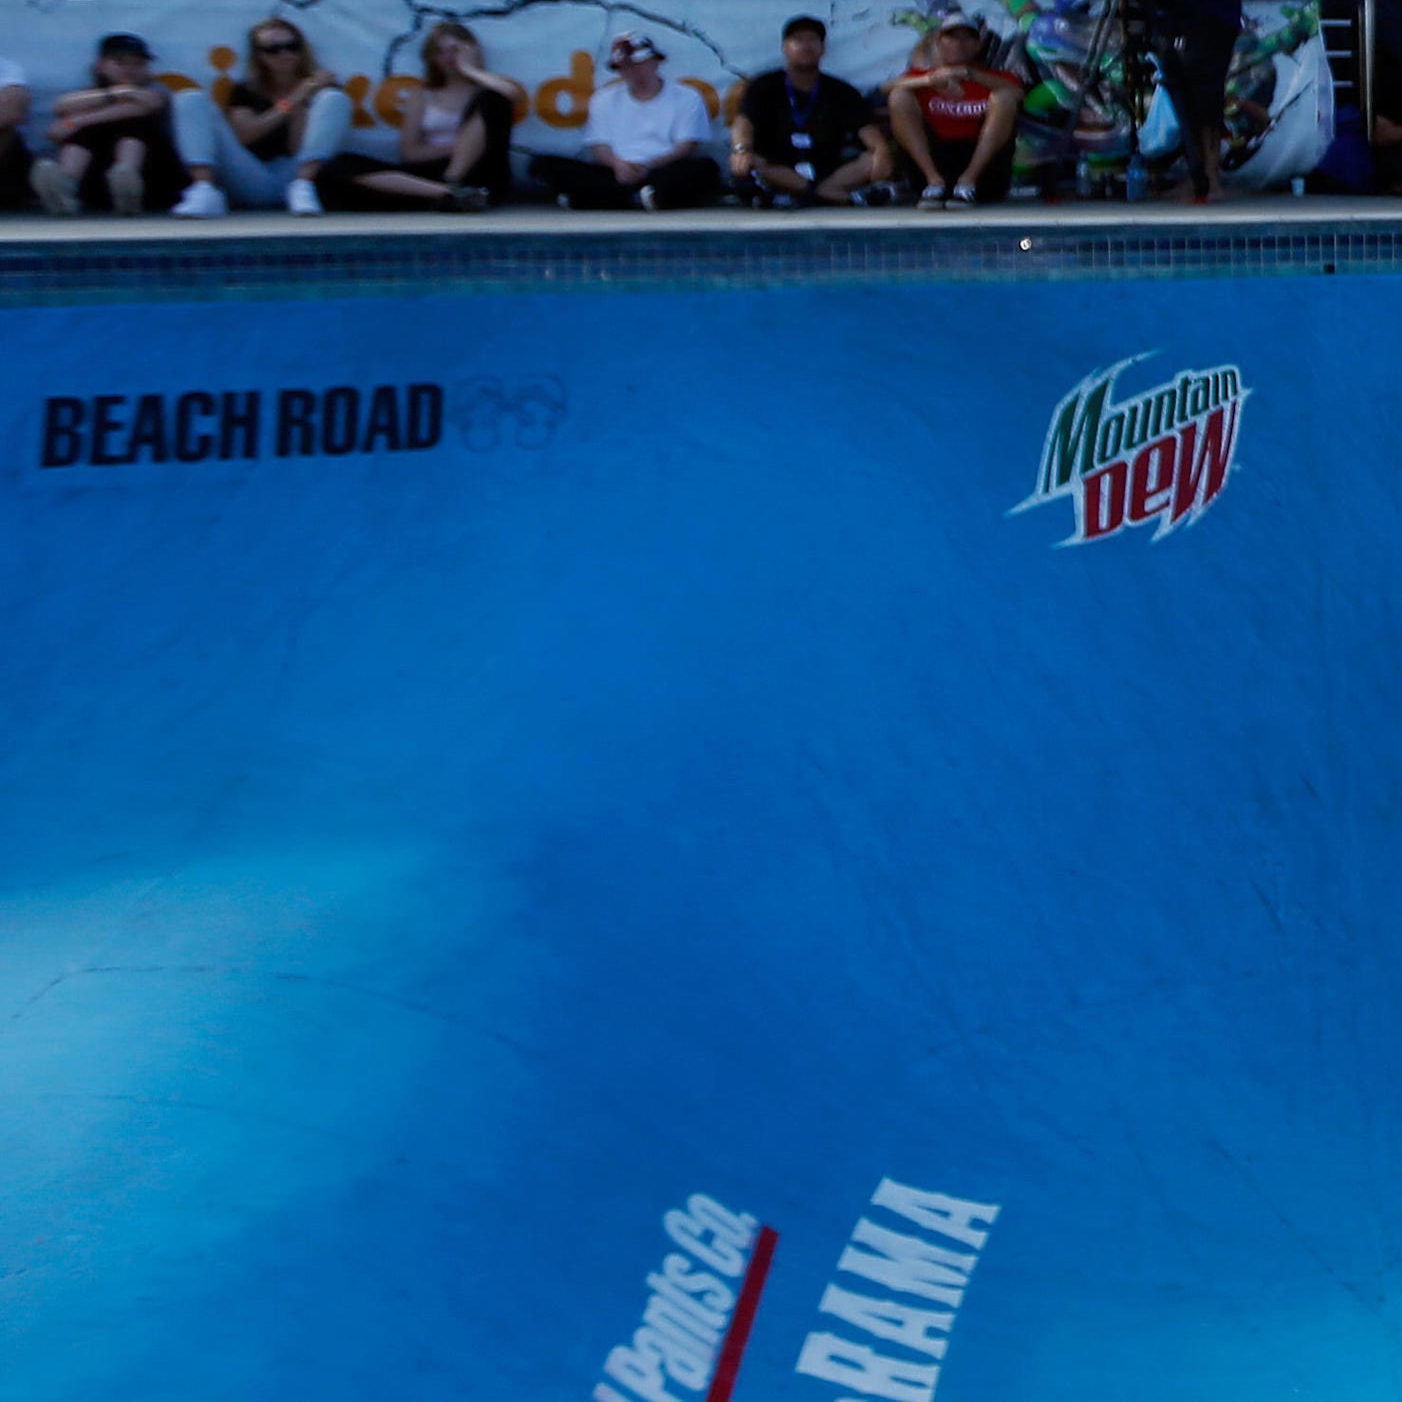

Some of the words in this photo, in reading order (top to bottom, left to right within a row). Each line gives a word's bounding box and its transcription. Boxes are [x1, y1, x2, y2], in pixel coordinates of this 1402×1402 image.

[40, 390, 262, 469] BEACH
[274, 383, 445, 458] ROAD
[1040, 367, 1241, 496] Mountain
